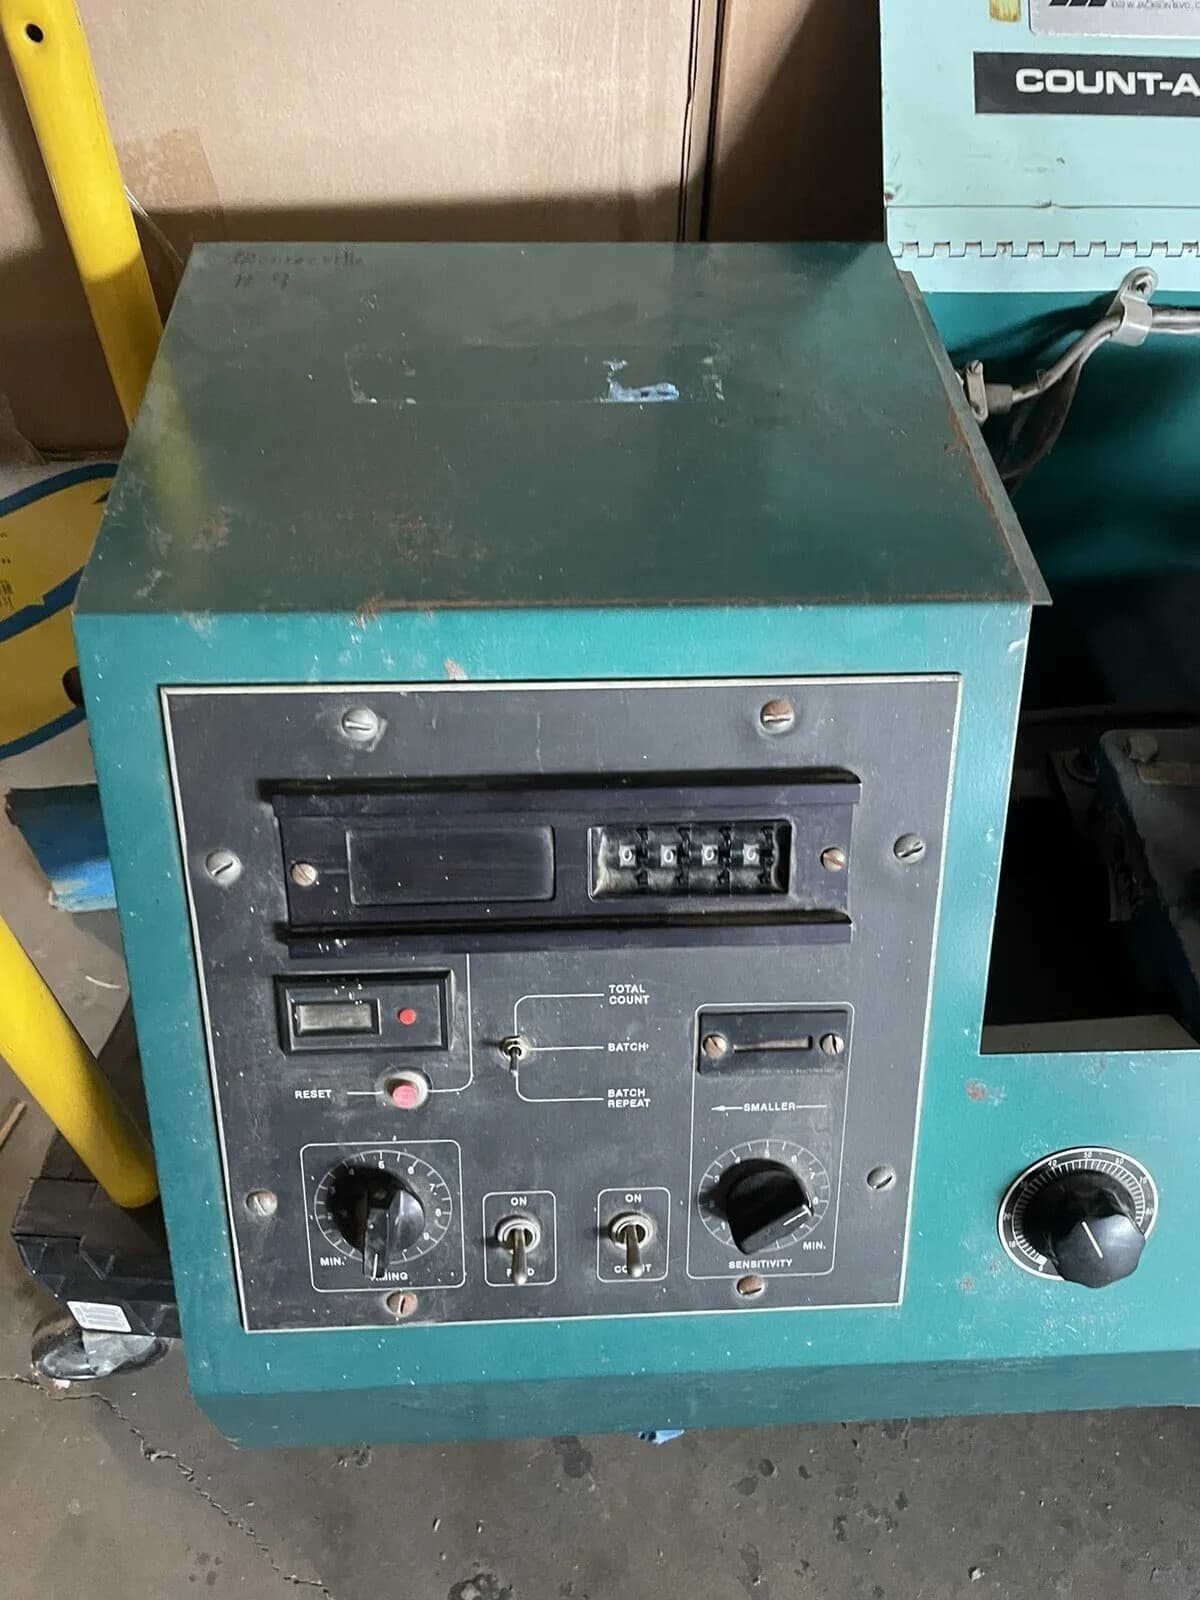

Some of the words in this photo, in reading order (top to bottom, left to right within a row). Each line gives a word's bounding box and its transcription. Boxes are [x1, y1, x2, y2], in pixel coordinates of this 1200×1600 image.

[608, 984, 646, 994] TOTAL
[608, 995, 650, 1005] COUNT
[607, 1042, 647, 1051] BATCH
[294, 1089, 332, 1099] RESET
[607, 1088, 646, 1098] BATCH
[607, 1099, 651, 1108] REPEAT
[743, 1102, 796, 1112] SMALLER
[510, 1196, 527, 1206] ON
[624, 1193, 642, 1203] ON
[802, 1241, 827, 1251] MIN.
[319, 1257, 345, 1267] MIN.
[728, 1259, 793, 1269] SENSITIVITY
[506, 1267, 535, 1278] FD
